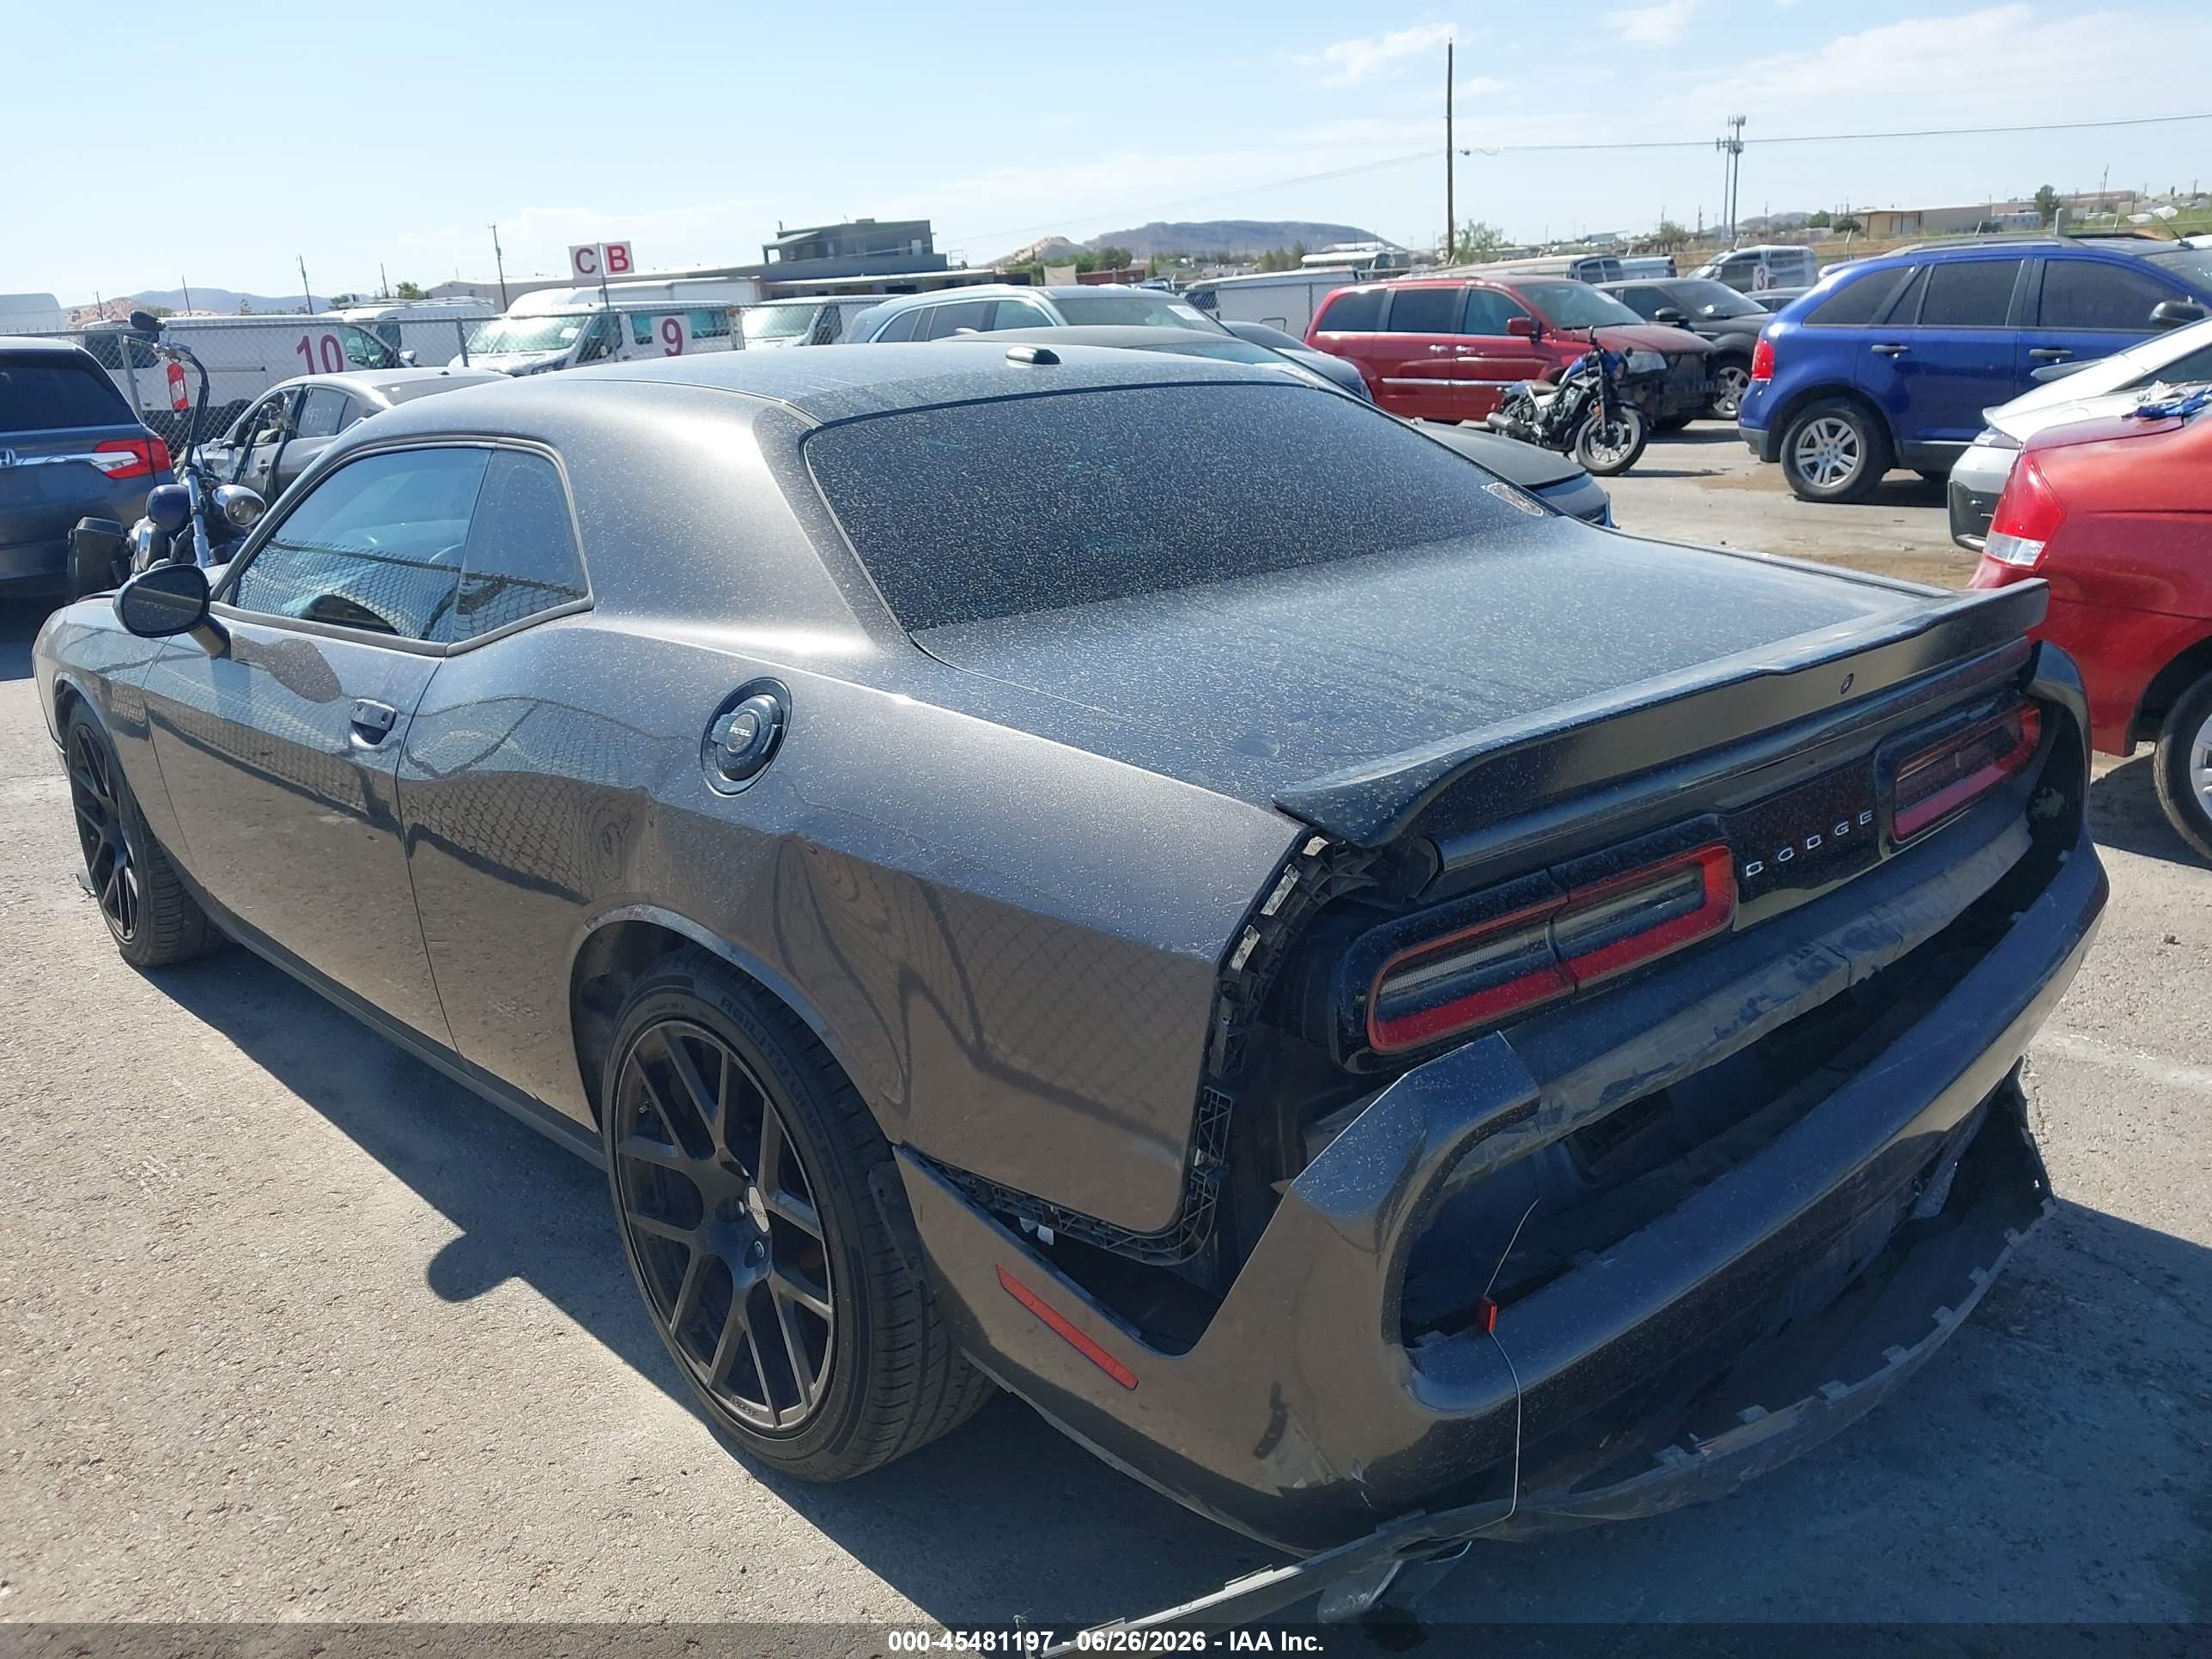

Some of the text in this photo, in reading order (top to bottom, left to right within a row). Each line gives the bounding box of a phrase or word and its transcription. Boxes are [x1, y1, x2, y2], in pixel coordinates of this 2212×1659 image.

[575, 247, 597, 274] C
[606, 245, 629, 272] B
[1757, 267, 1765, 290] 3
[661, 318, 684, 357] 9
[296, 334, 343, 374] 10
[728, 726, 752, 737] FUEL
[1746, 810, 1873, 878] DODGE
